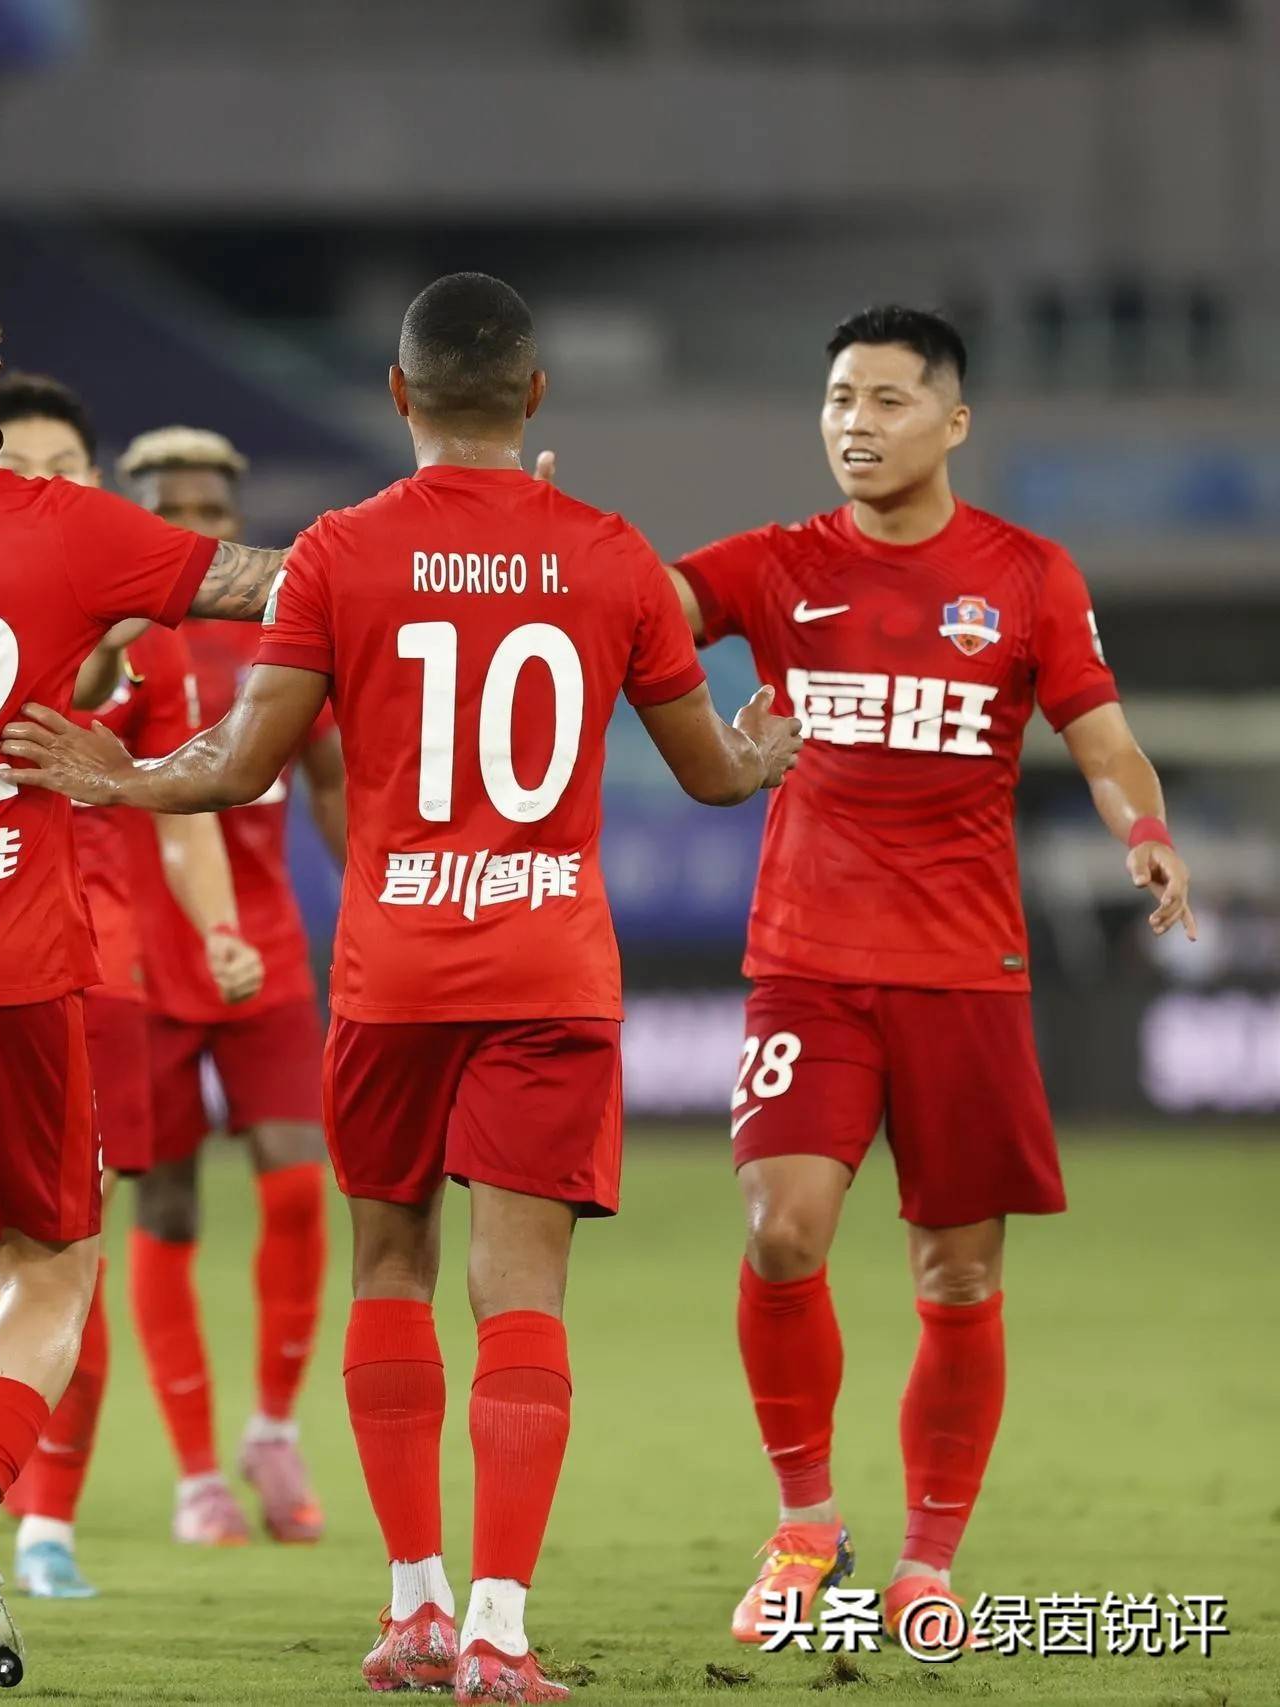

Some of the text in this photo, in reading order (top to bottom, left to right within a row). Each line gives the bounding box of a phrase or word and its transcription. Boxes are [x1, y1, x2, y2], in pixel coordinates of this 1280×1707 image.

[413, 551, 569, 594] RODRIGO H.
[397, 621, 584, 823] 10
[378, 848, 582, 922] 晋川智能
[730, 1030, 802, 1110] 28
